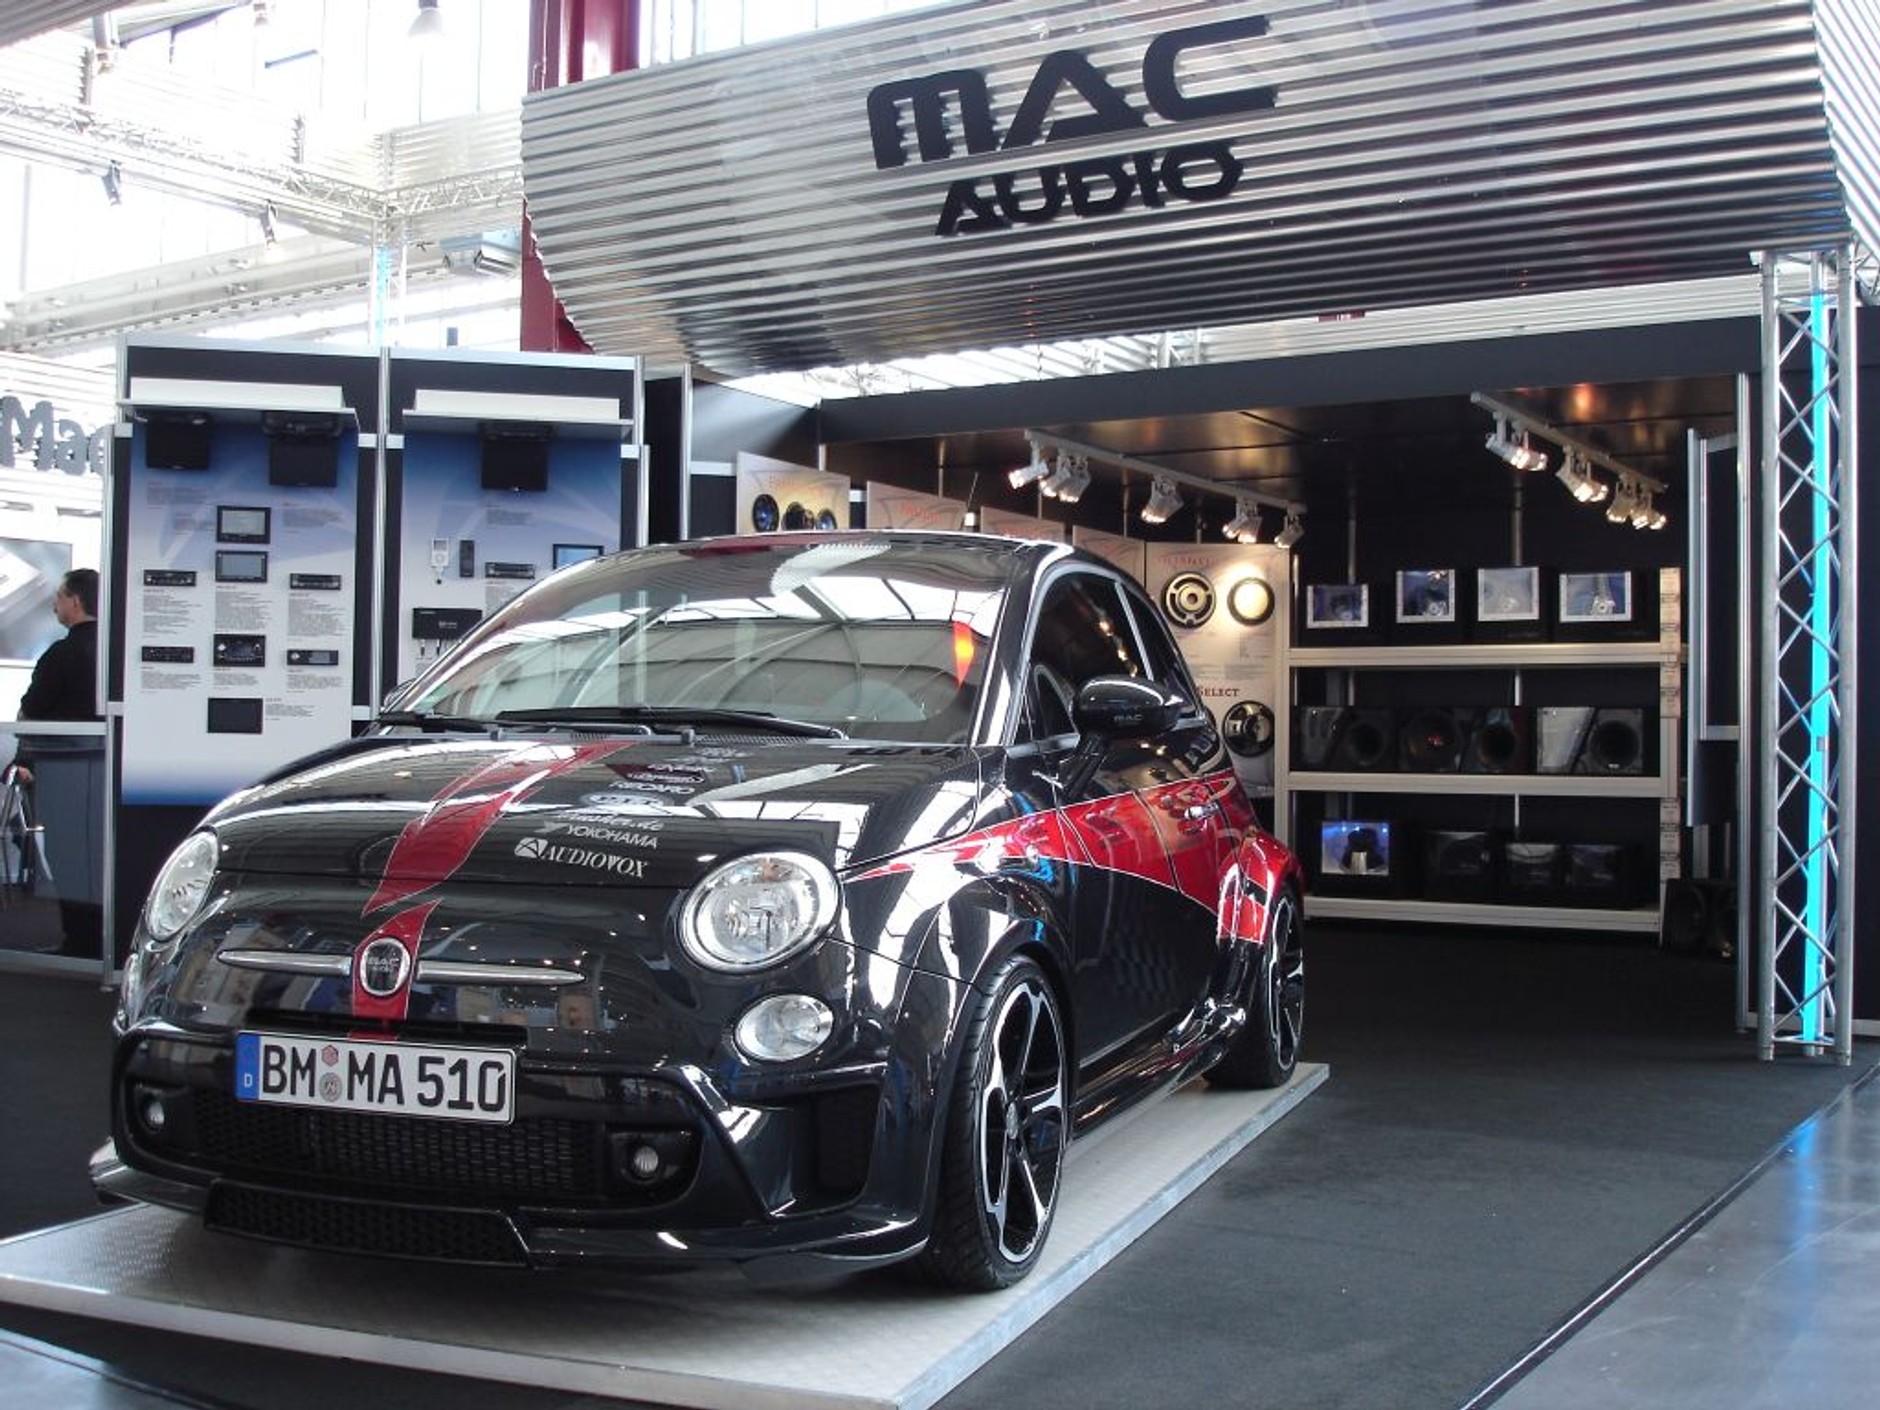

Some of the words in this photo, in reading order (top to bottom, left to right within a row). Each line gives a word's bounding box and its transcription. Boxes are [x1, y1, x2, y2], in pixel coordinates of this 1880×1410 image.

[935, 140, 1244, 236] AUDIO
[540, 845, 648, 878] AUDIOVOX
[566, 823, 659, 850] YOKOHAMA
[262, 1044, 317, 1097] BM
[347, 1050, 405, 1105] MA
[416, 1055, 506, 1112] 510
